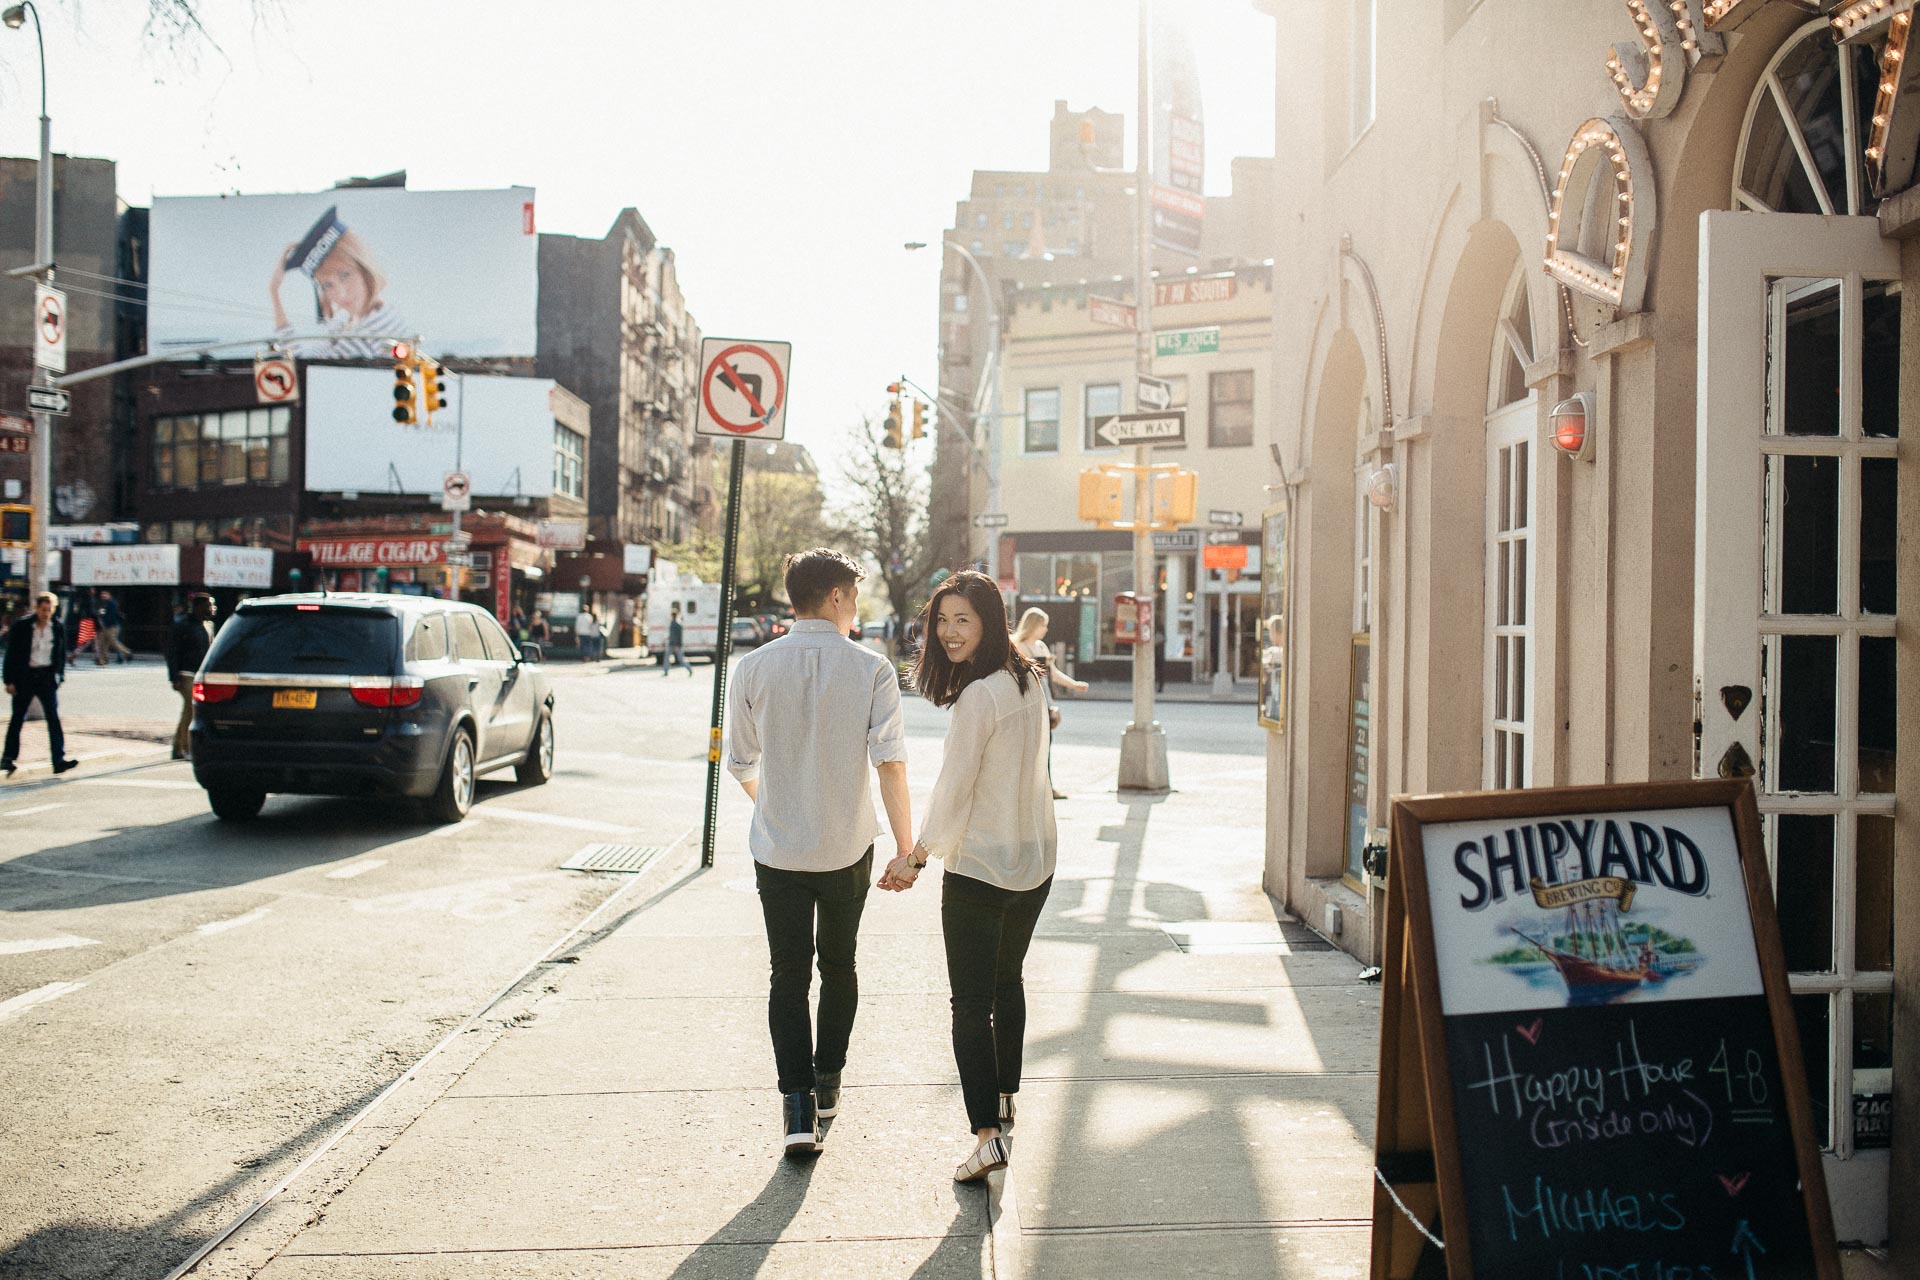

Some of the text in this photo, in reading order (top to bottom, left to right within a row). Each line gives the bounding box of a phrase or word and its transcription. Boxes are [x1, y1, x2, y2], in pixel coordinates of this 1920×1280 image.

[1158, 334, 1182, 349] WES
[1185, 331, 1217, 347] JOICE
[1111, 423, 1173, 437] ONE WAY
[309, 542, 375, 563] VILLAGE
[377, 540, 440, 564] CIGARS
[1454, 819, 1709, 912] SHIPYARD
[1545, 881, 1600, 906] BREWING
[1467, 1018, 1768, 1120] Happy Hour 4-8
[1502, 1175, 1686, 1241] MICHAEL'S
